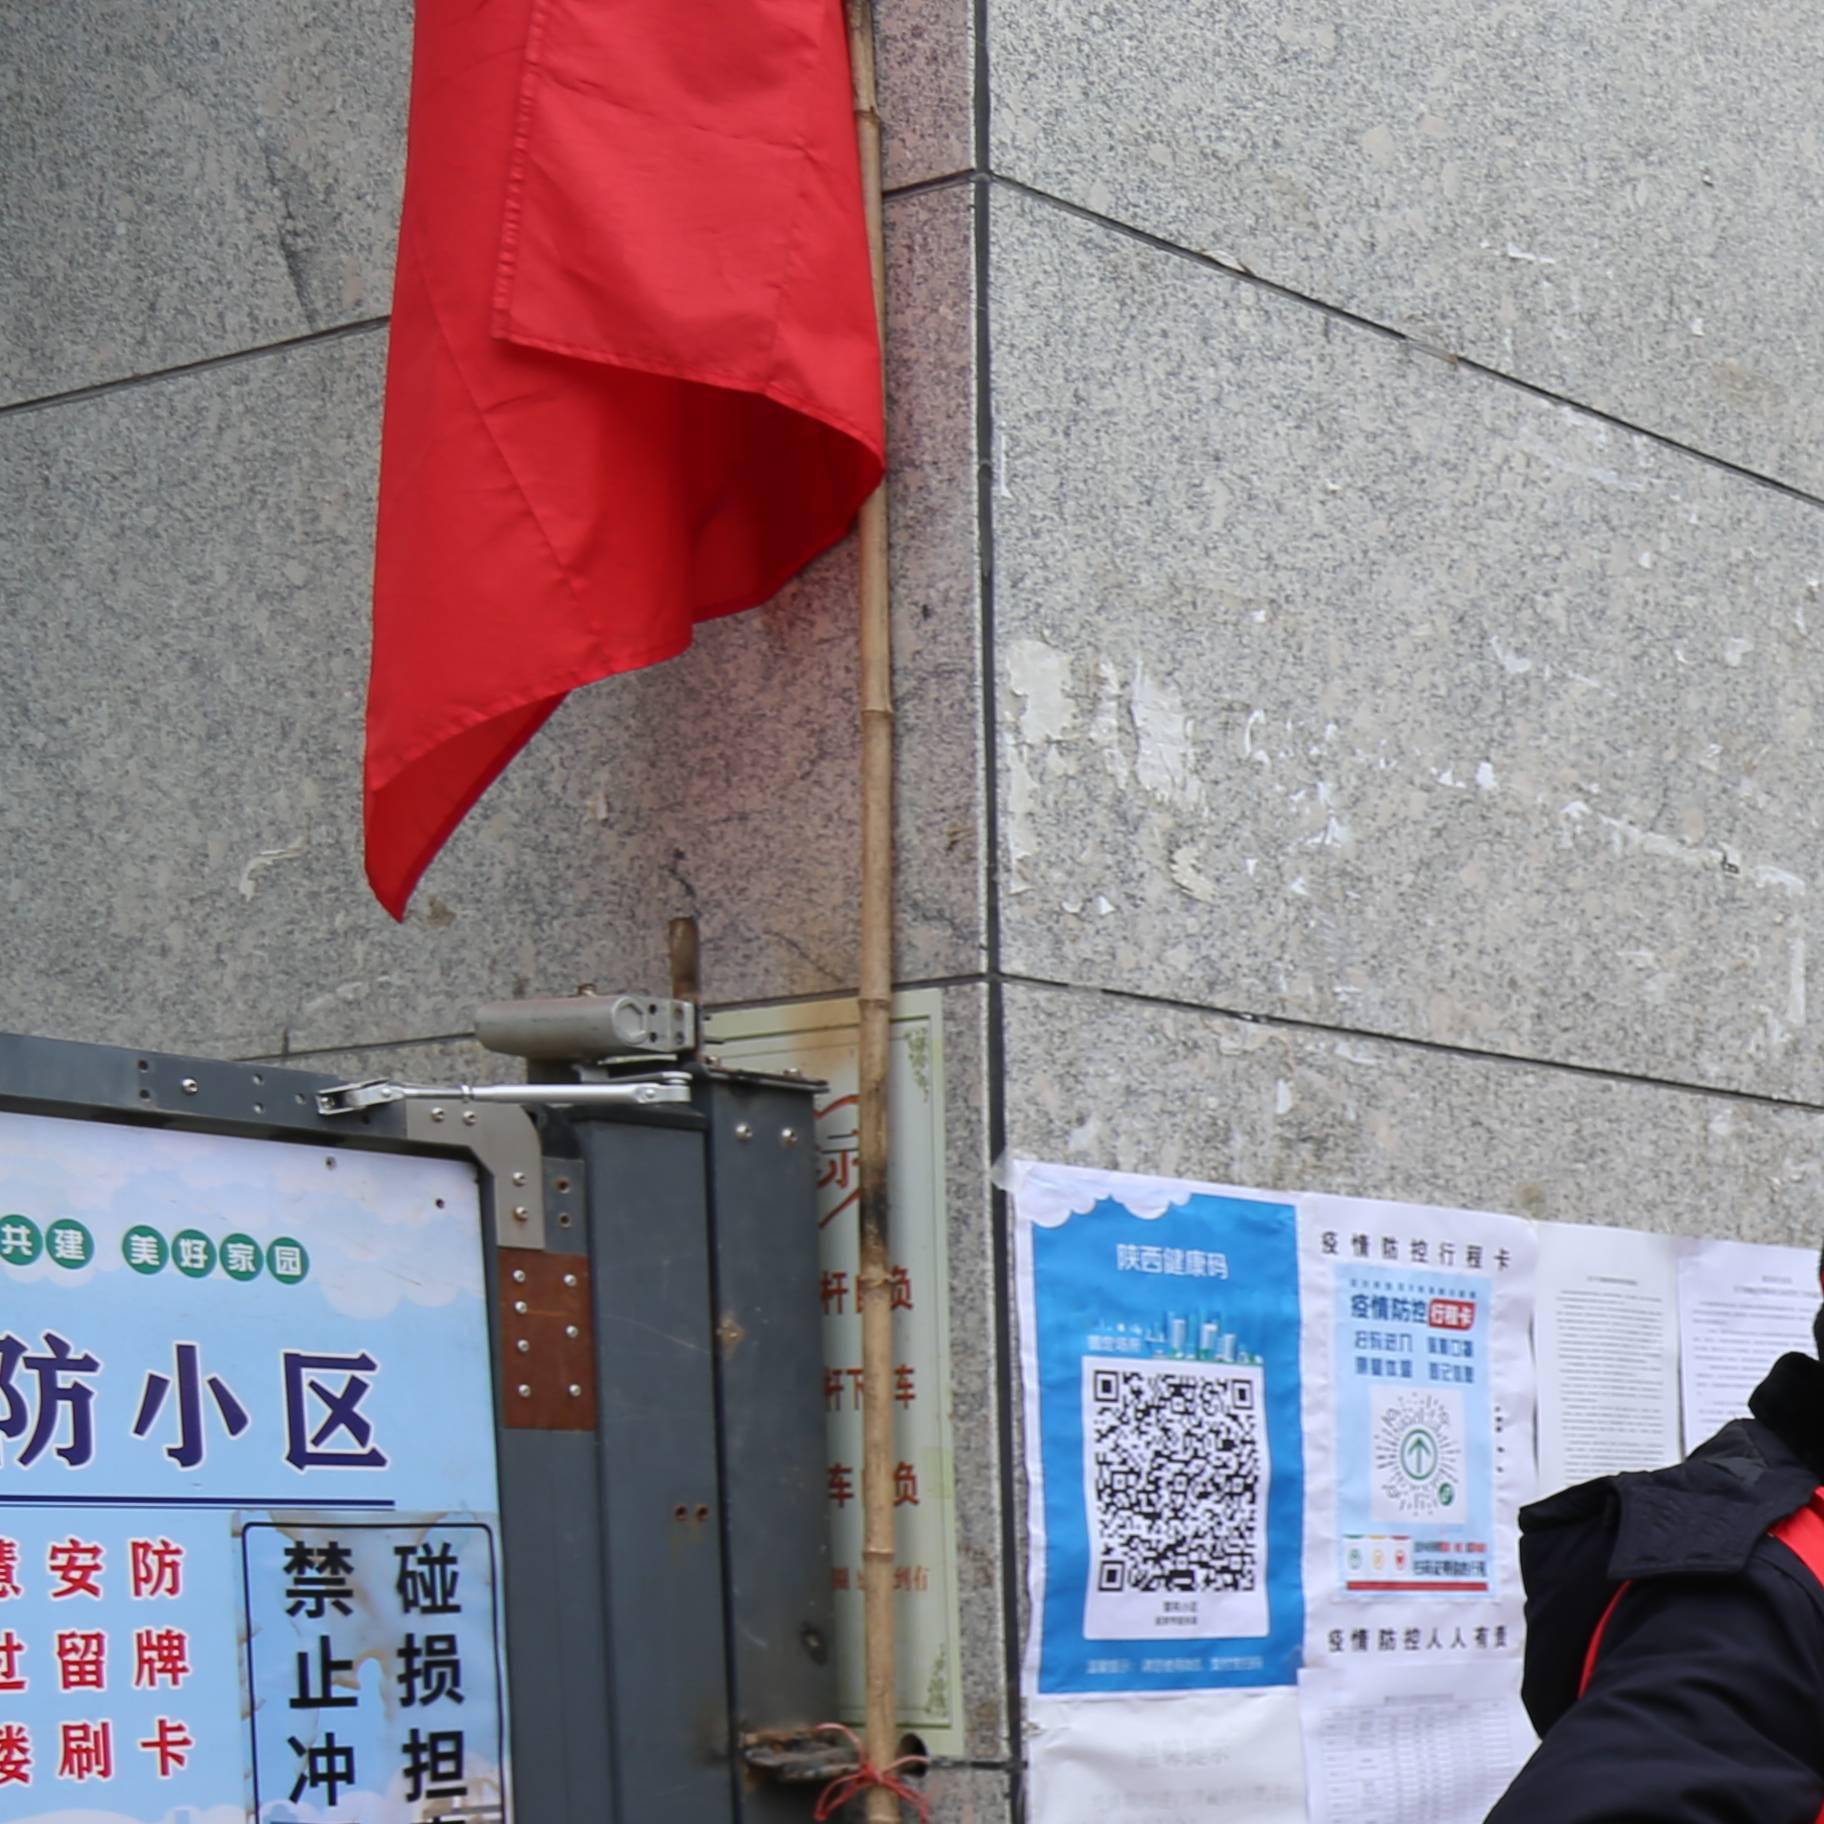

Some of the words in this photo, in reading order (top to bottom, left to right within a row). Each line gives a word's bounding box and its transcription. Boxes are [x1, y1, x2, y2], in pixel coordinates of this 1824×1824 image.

[1, 1224, 85, 1260] 共建
[128, 1234, 304, 1277] 美好家园
[1116, 1243, 1229, 1280] 陕西健康码
[1321, 1231, 1510, 1271] 疫情防控行程卡
[0, 1331, 389, 1471] 防小区
[1328, 1625, 1507, 1651] 疫情防控人人有责
